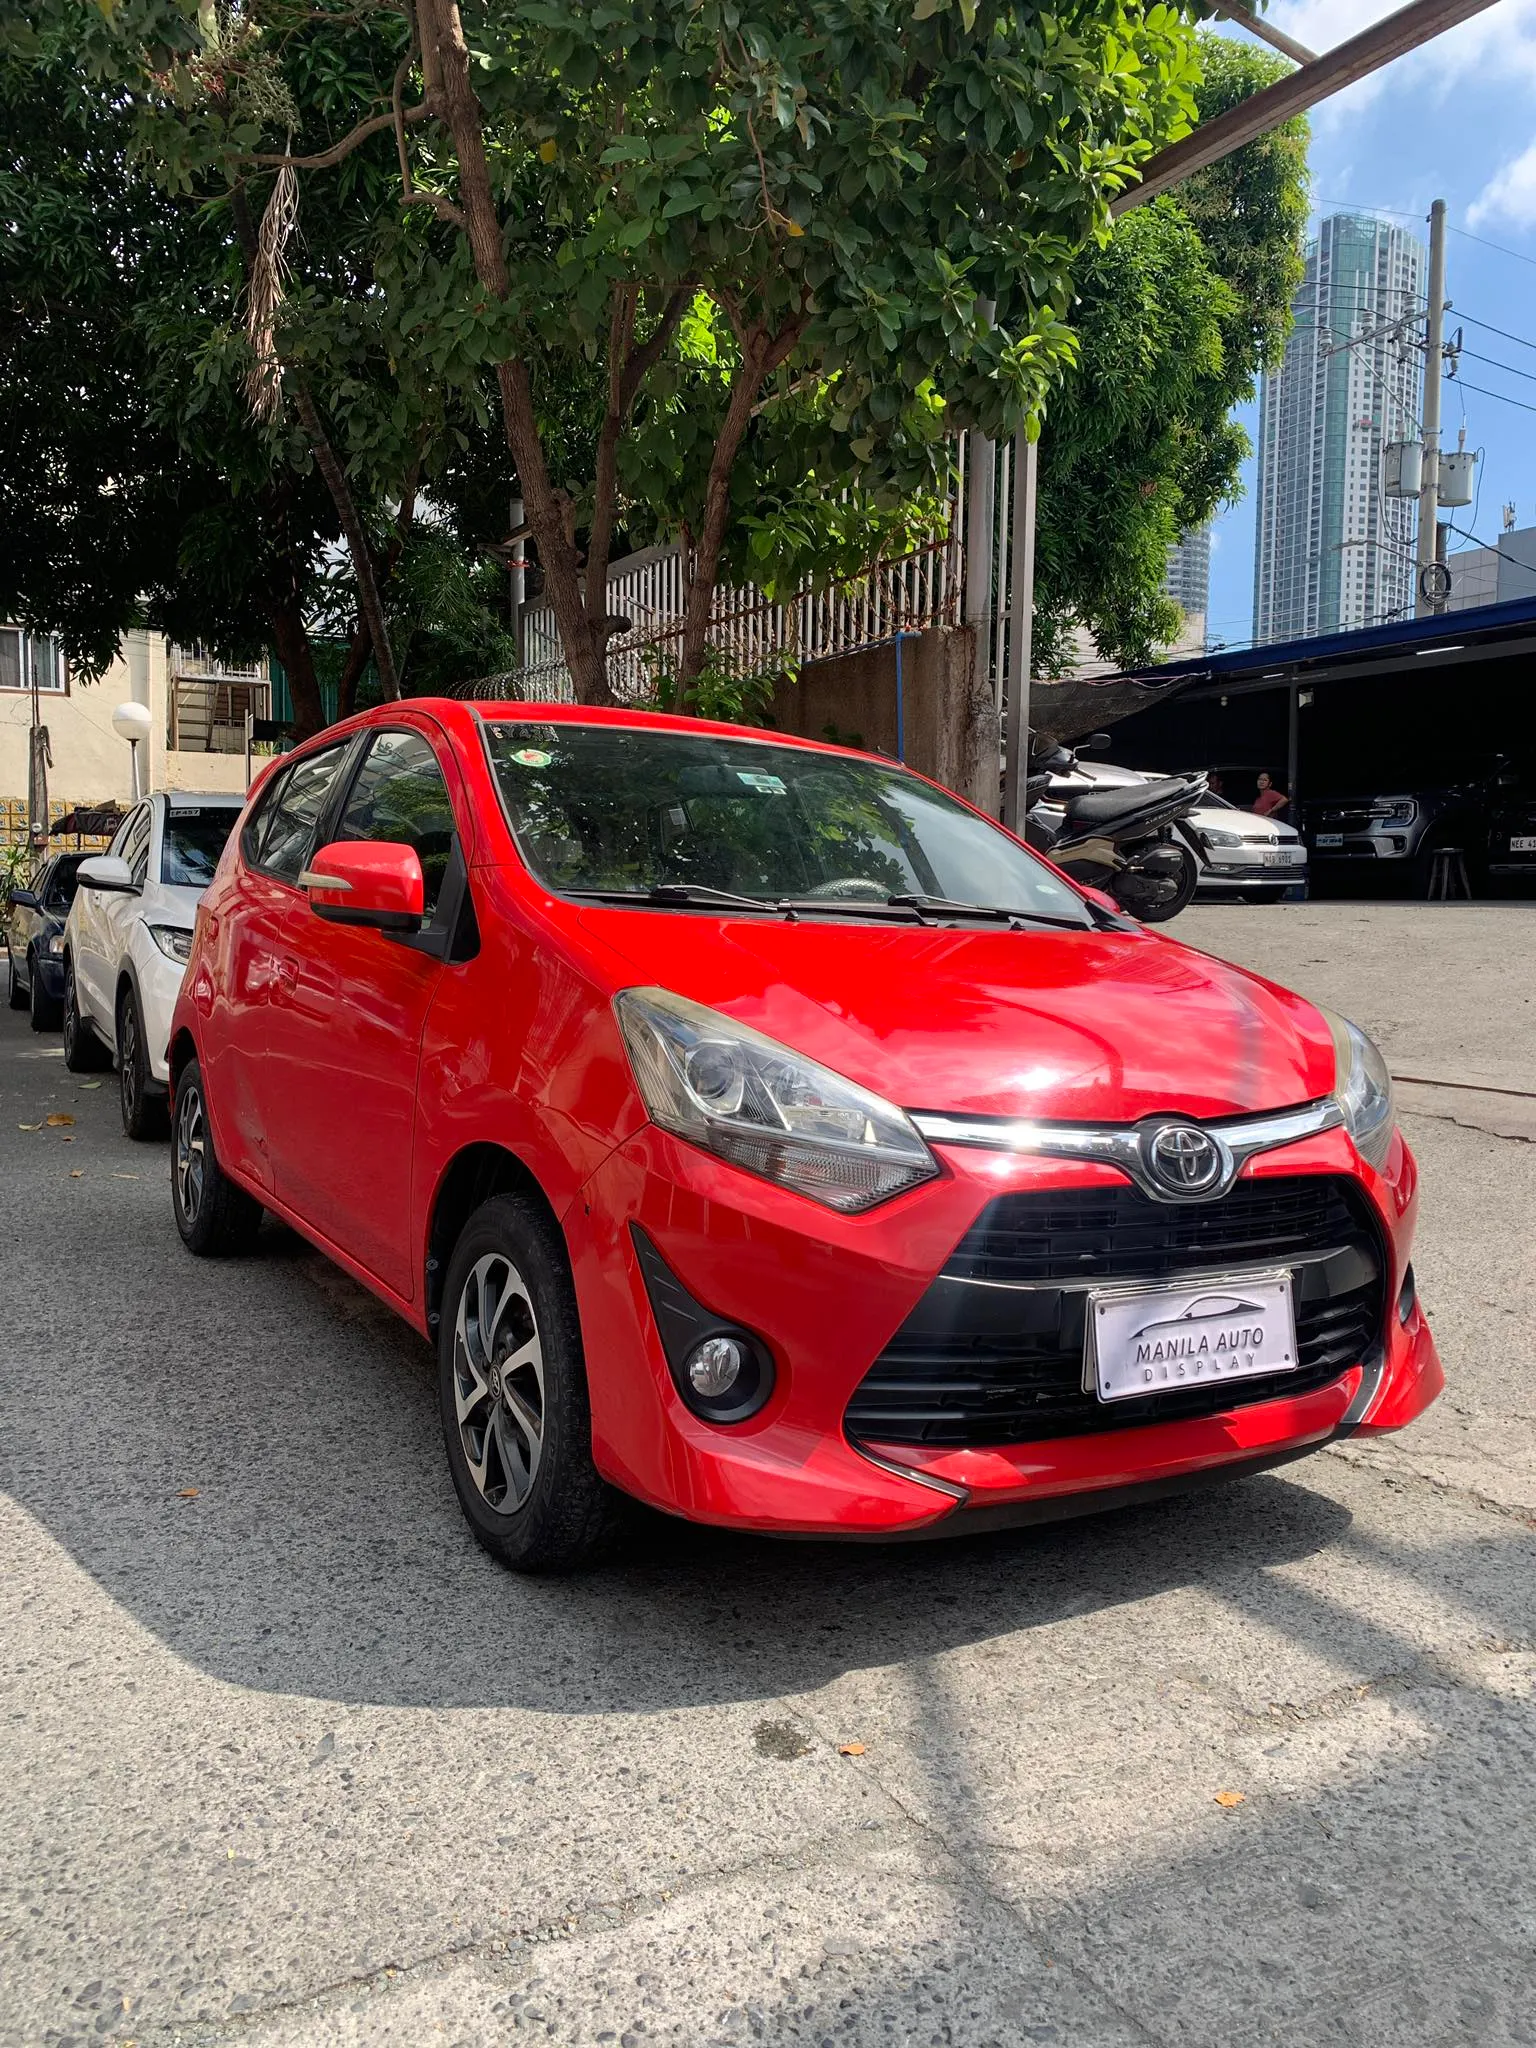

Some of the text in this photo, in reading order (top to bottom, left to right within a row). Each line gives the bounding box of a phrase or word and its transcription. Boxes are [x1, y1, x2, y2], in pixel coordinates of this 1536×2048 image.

[1136, 1327, 1264, 1363] MANILA AUTO
[1144, 1353, 1256, 1382] DISPLAY
